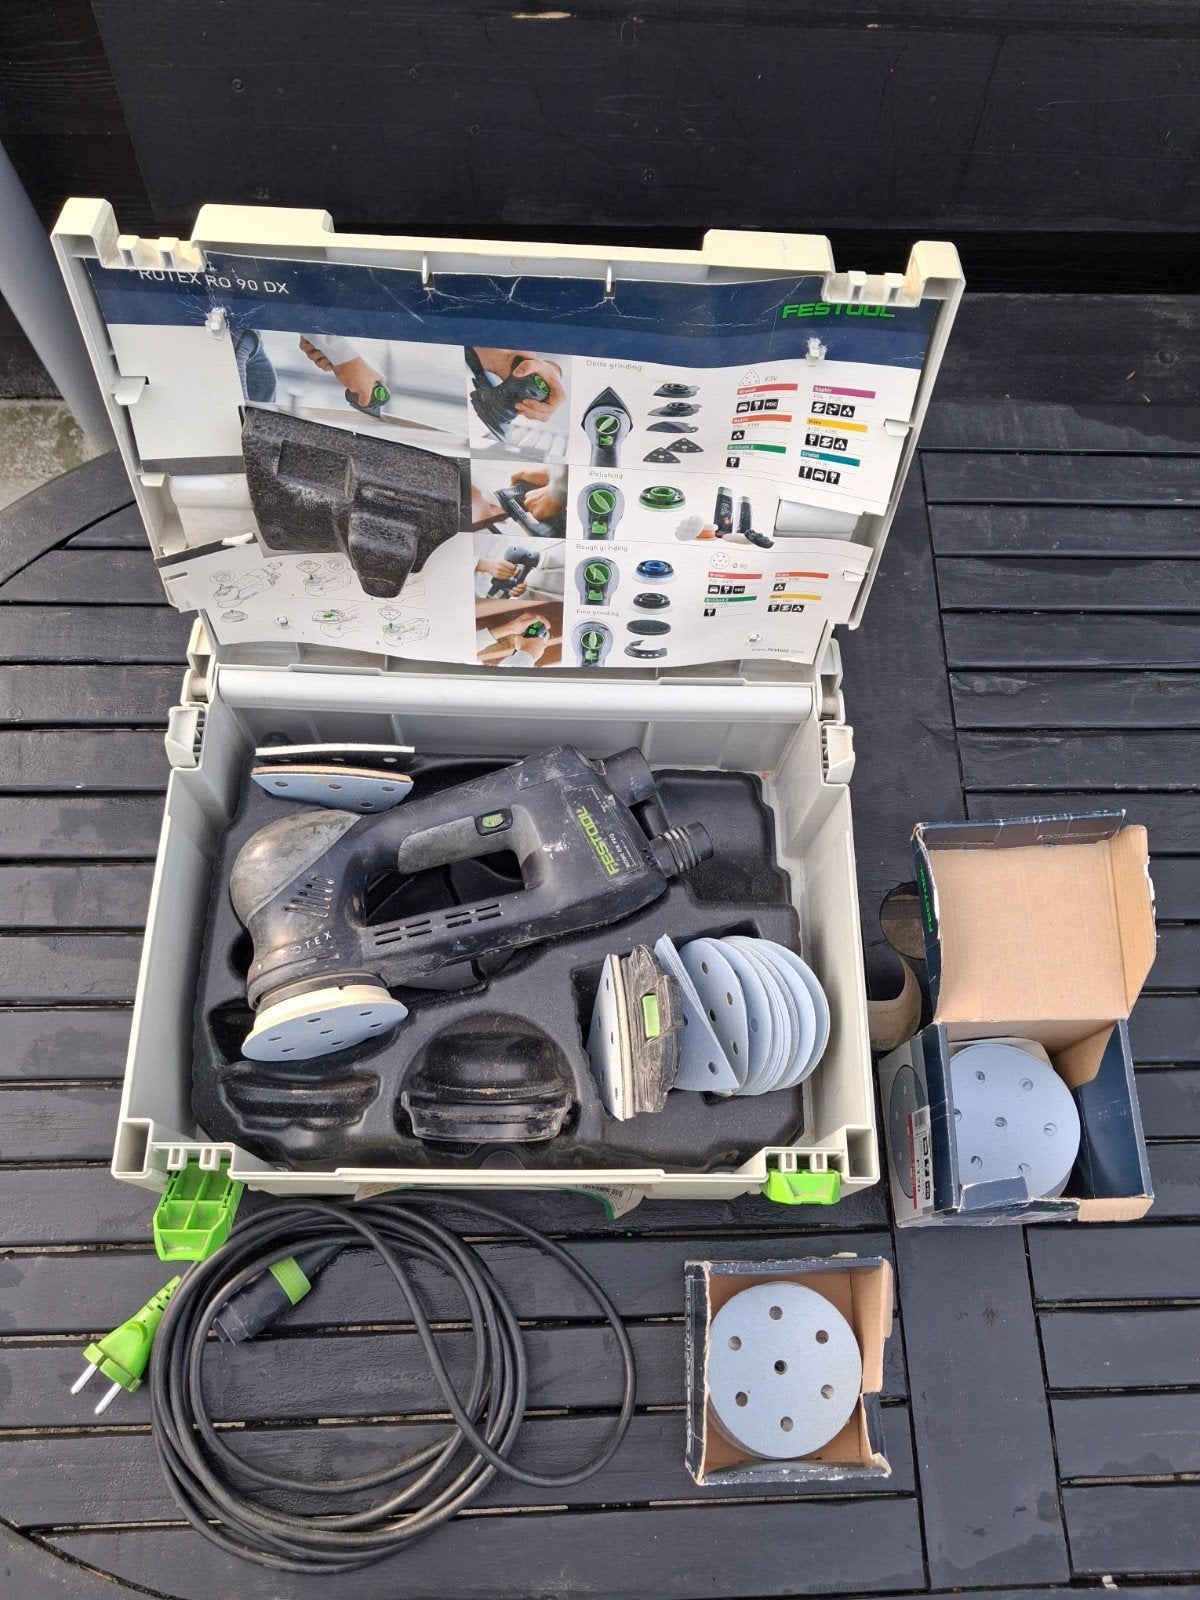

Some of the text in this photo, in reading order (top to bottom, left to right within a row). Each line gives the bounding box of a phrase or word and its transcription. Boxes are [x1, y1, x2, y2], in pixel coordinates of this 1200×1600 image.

[205, 273, 232, 289] RO
[236, 278, 259, 292] 90
[263, 281, 290, 295] DX
[782, 302, 896, 319] FESTOOL
[586, 359, 642, 372] Delta grinding
[590, 471, 624, 480] Polishing
[576, 543, 598, 551] Rough
[578, 805, 620, 876] FESTOOL
